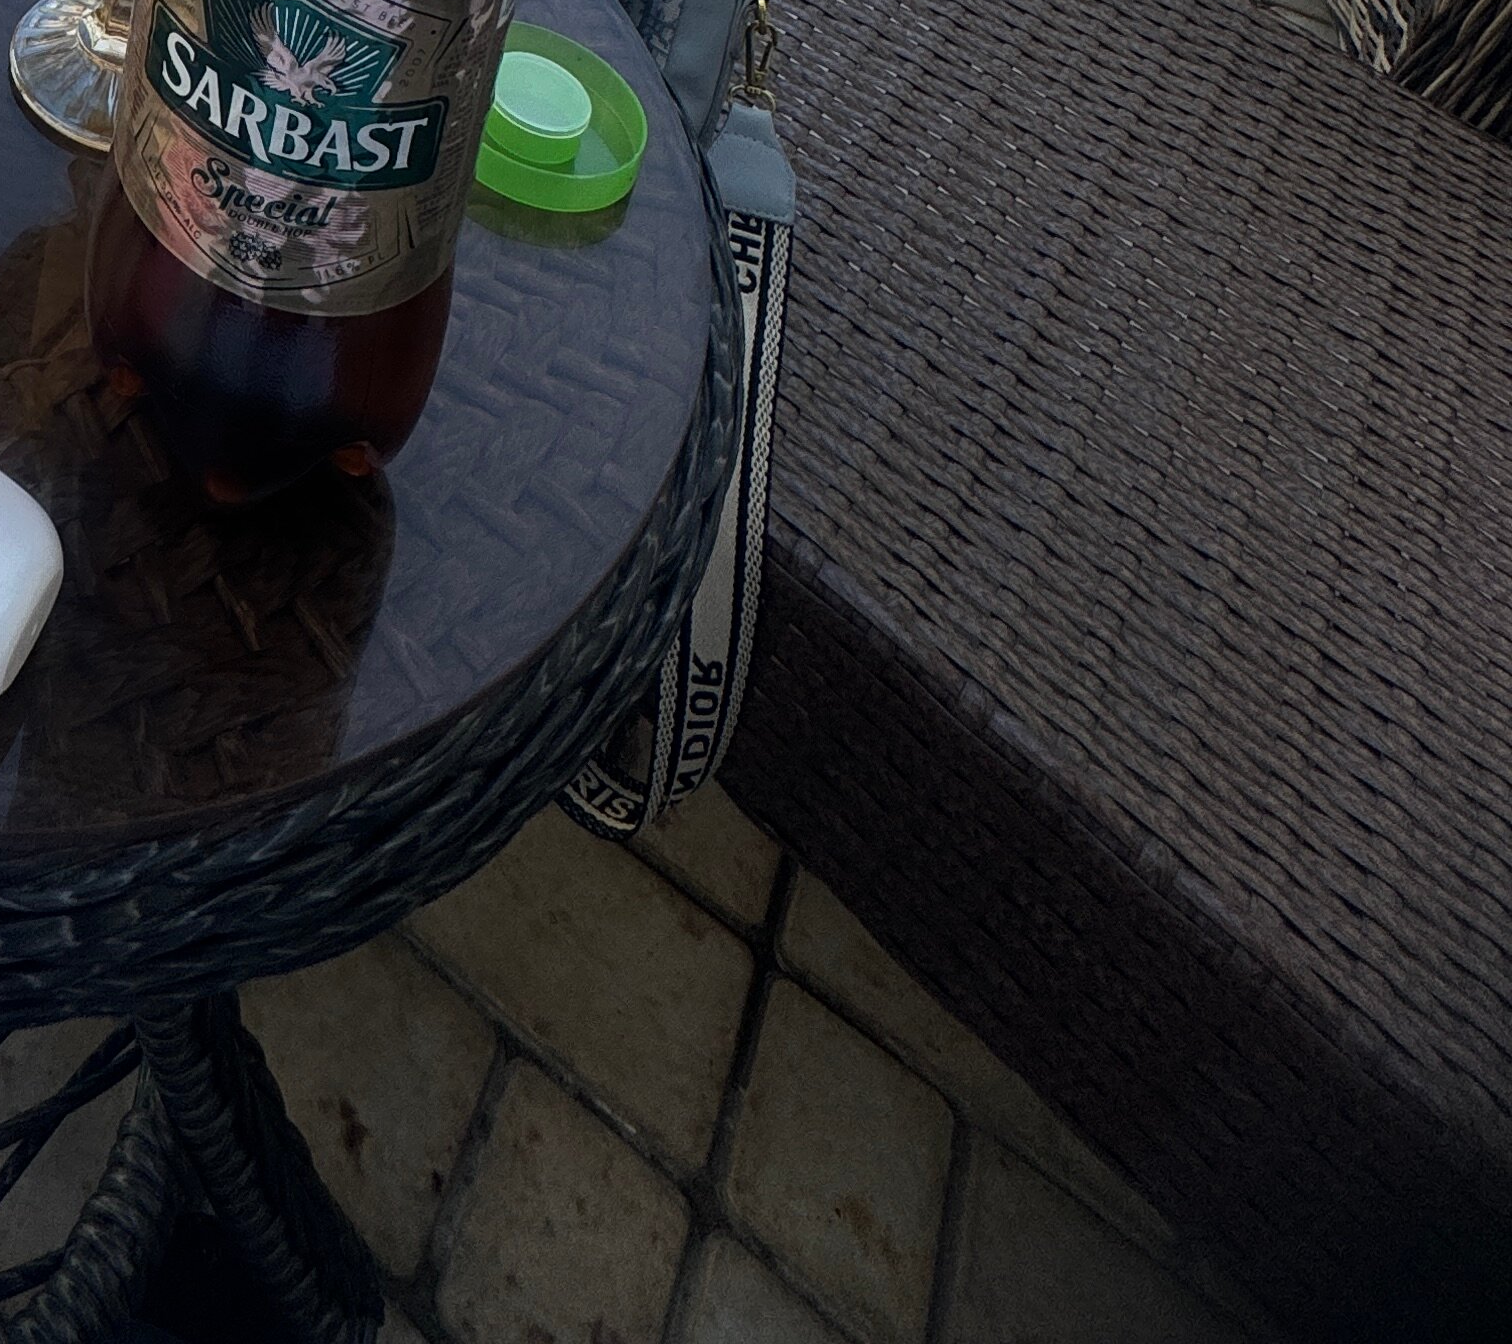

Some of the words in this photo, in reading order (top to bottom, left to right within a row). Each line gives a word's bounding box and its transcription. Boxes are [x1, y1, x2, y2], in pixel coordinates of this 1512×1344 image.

[377, 10, 417, 31] BEER
[161, 31, 429, 173] SARBAST
[191, 157, 338, 228] Special
[282, 225, 313, 239] HOP
